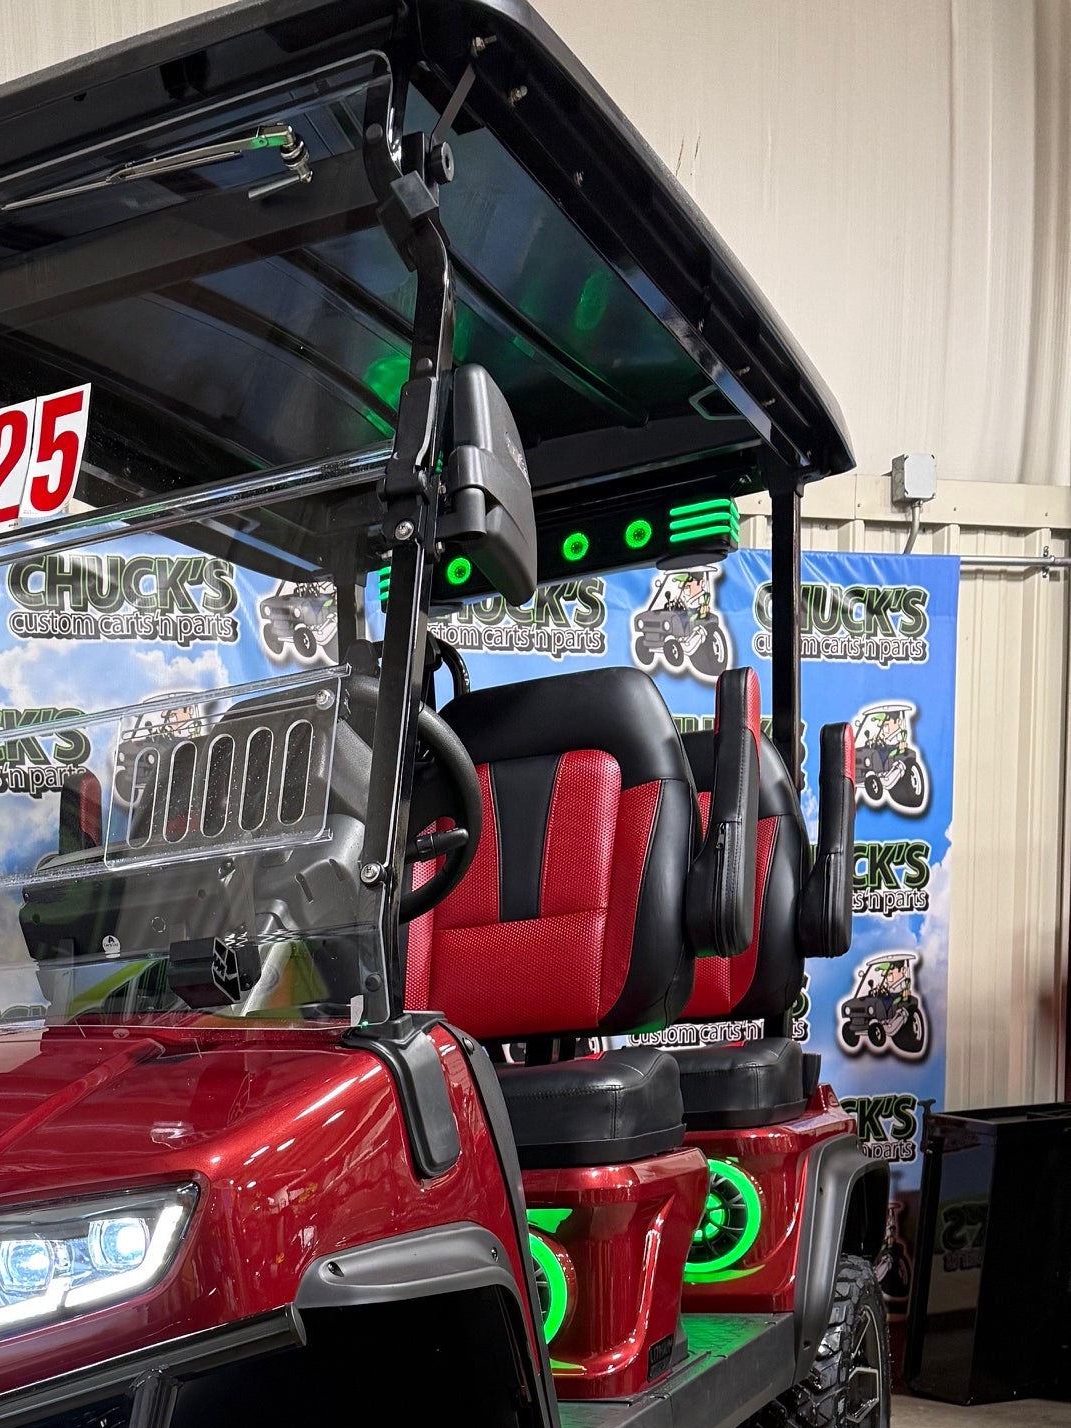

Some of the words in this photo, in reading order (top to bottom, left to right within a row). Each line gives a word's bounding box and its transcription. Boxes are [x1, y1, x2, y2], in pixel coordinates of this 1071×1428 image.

[8, 555, 236, 613] CHUCK'S
[10, 611, 97, 638] custom
[178, 614, 235, 645] parts
[552, 628, 604, 656] parts
[879, 637, 926, 664] parts
[883, 889, 928, 915] parts
